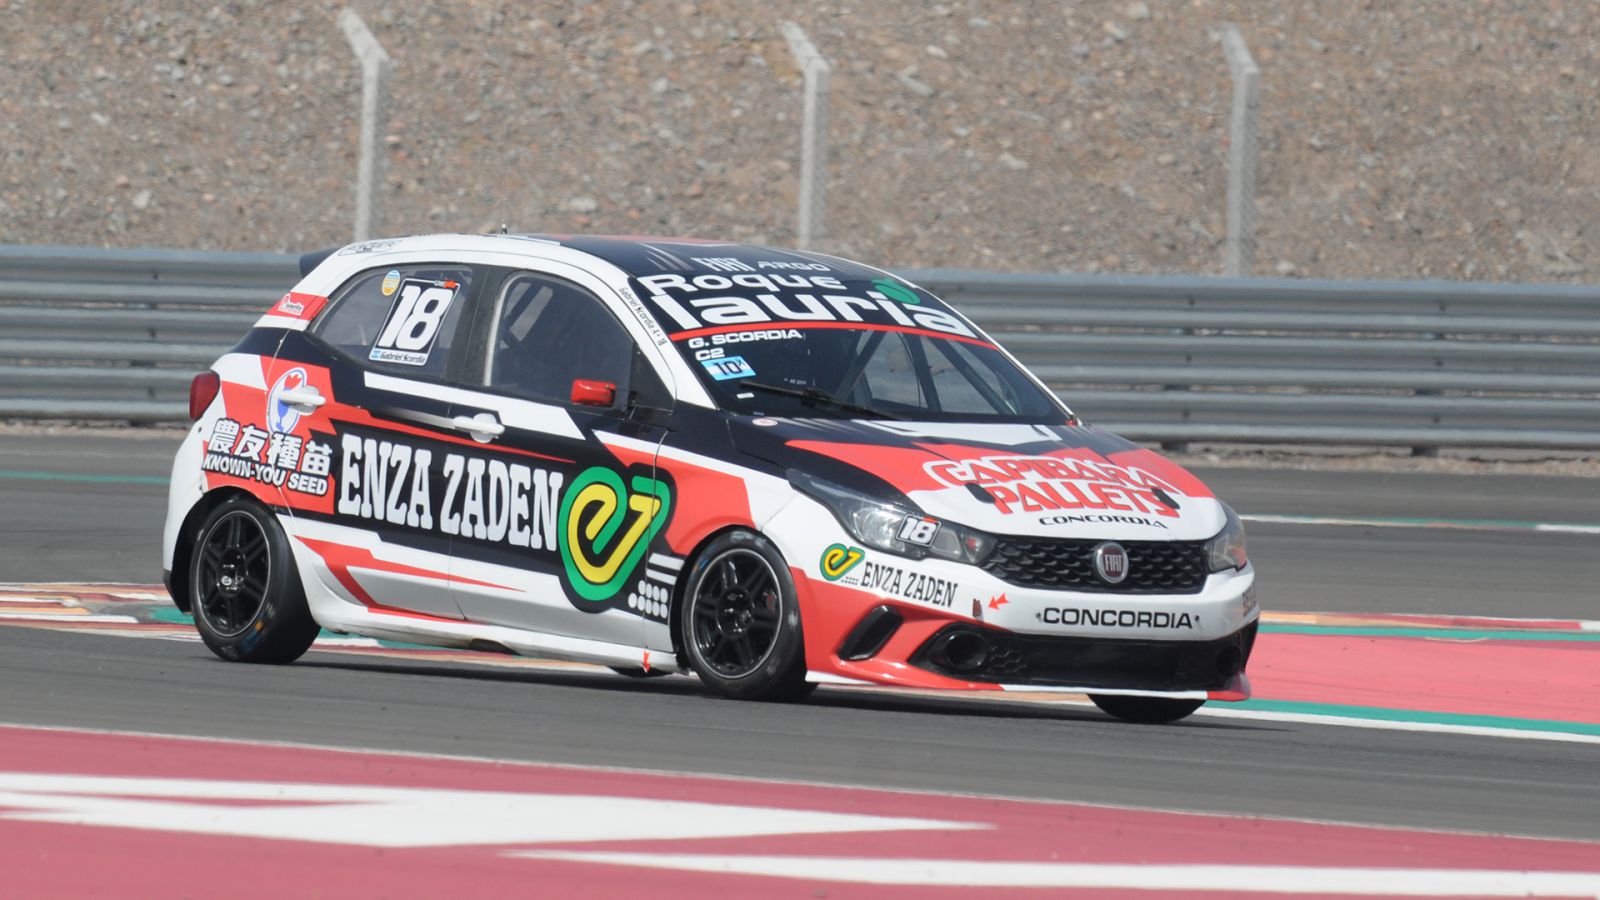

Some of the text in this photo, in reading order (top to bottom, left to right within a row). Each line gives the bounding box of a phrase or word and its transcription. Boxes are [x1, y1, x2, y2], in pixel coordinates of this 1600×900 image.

[690, 257, 831, 272] FIAT ARGO
[377, 285, 454, 350] 18
[650, 292, 979, 338] lauria
[688, 329, 803, 349] G. SCORDIA
[695, 347, 725, 361] C2
[206, 418, 334, 478] 農友種苗
[201, 452, 329, 496] KNOWN-YOU SEED
[338, 433, 564, 552] ENZA ZADEN
[922, 455, 1181, 496] CAPIBARA
[979, 482, 1181, 519] PALLETS
[900, 517, 938, 544] 18
[1039, 515, 1170, 530] CONCORDIA
[1104, 554, 1123, 573] FIAT
[861, 562, 959, 608] ENZA ZADEN
[1043, 607, 1194, 629] CONCORDIA
